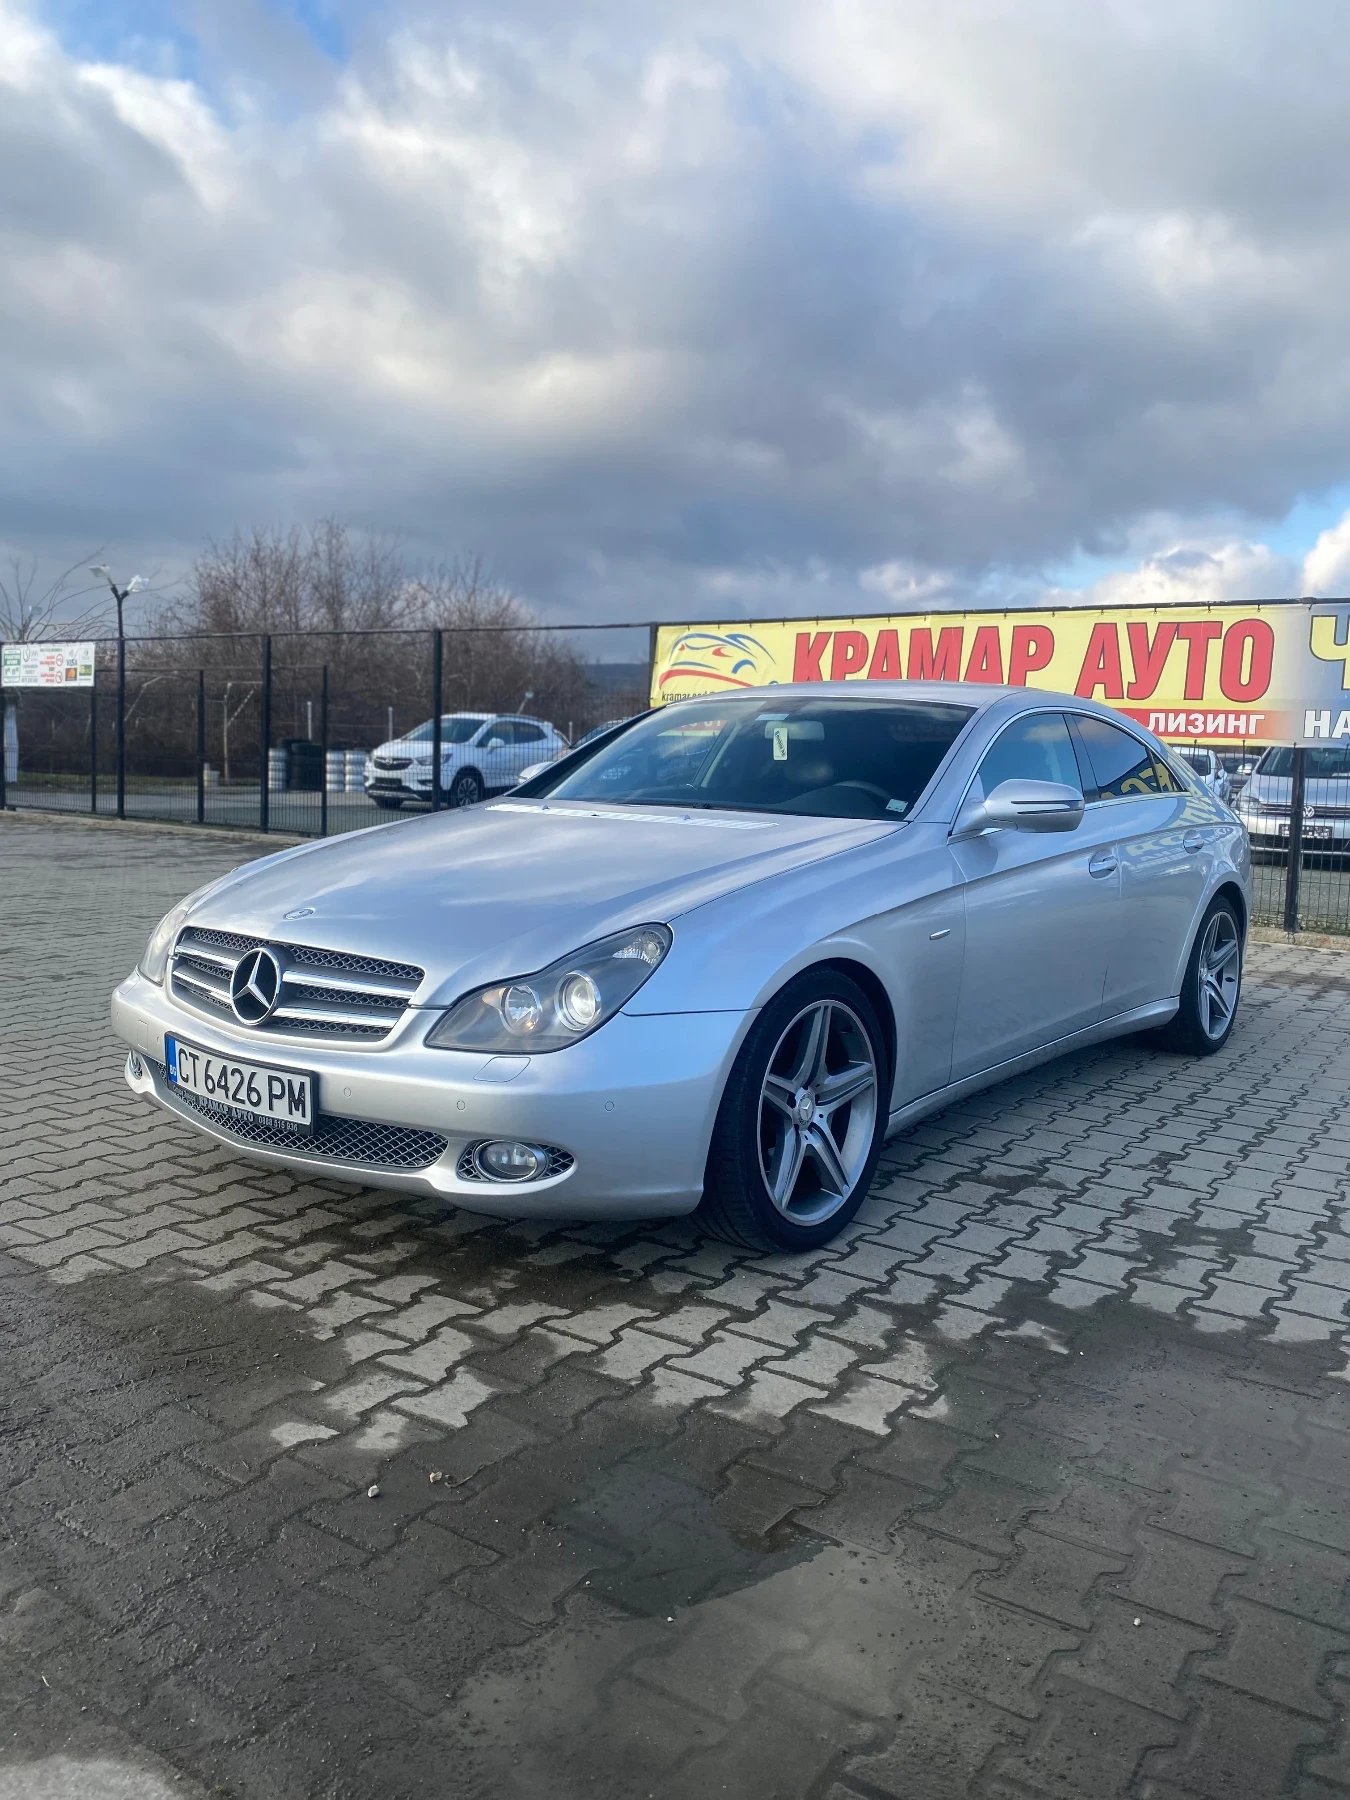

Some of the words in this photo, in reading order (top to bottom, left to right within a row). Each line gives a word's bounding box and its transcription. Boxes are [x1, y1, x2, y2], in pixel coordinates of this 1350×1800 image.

[792, 624, 1055, 687] КРАМАР
[1073, 618, 1275, 703] АУТО
[1309, 614, 1350, 690] Ч
[1147, 712, 1265, 735] ЛИЗИНГ
[169, 1063, 178, 1077] BG
[178, 1047, 200, 1088] CT
[204, 1059, 262, 1108] 6426
[267, 1074, 307, 1119] PM
